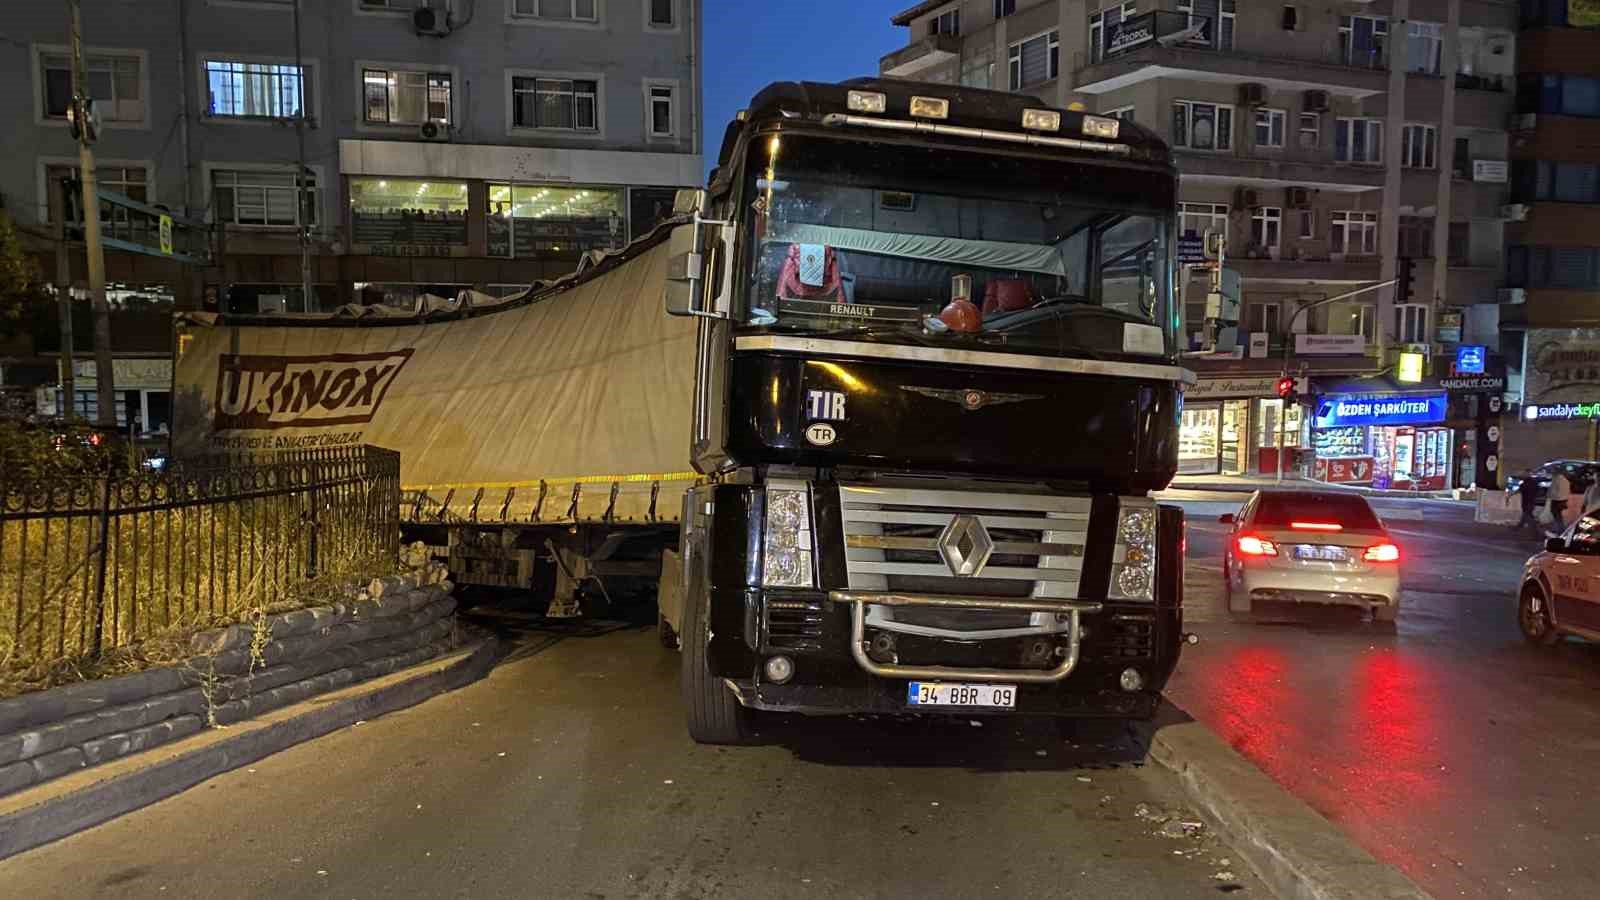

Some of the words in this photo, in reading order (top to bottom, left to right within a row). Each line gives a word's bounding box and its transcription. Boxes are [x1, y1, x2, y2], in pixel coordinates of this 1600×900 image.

[830, 304, 875, 317] RENAULT
[809, 391, 845, 420] TIR
[1337, 402, 1371, 417] ÖZDEN
[1374, 399, 1429, 417] ŞARKÜTERİ
[812, 429, 832, 440] TR
[920, 687, 938, 704] 34
[950, 687, 979, 705] BBR
[992, 689, 1012, 706] 09
